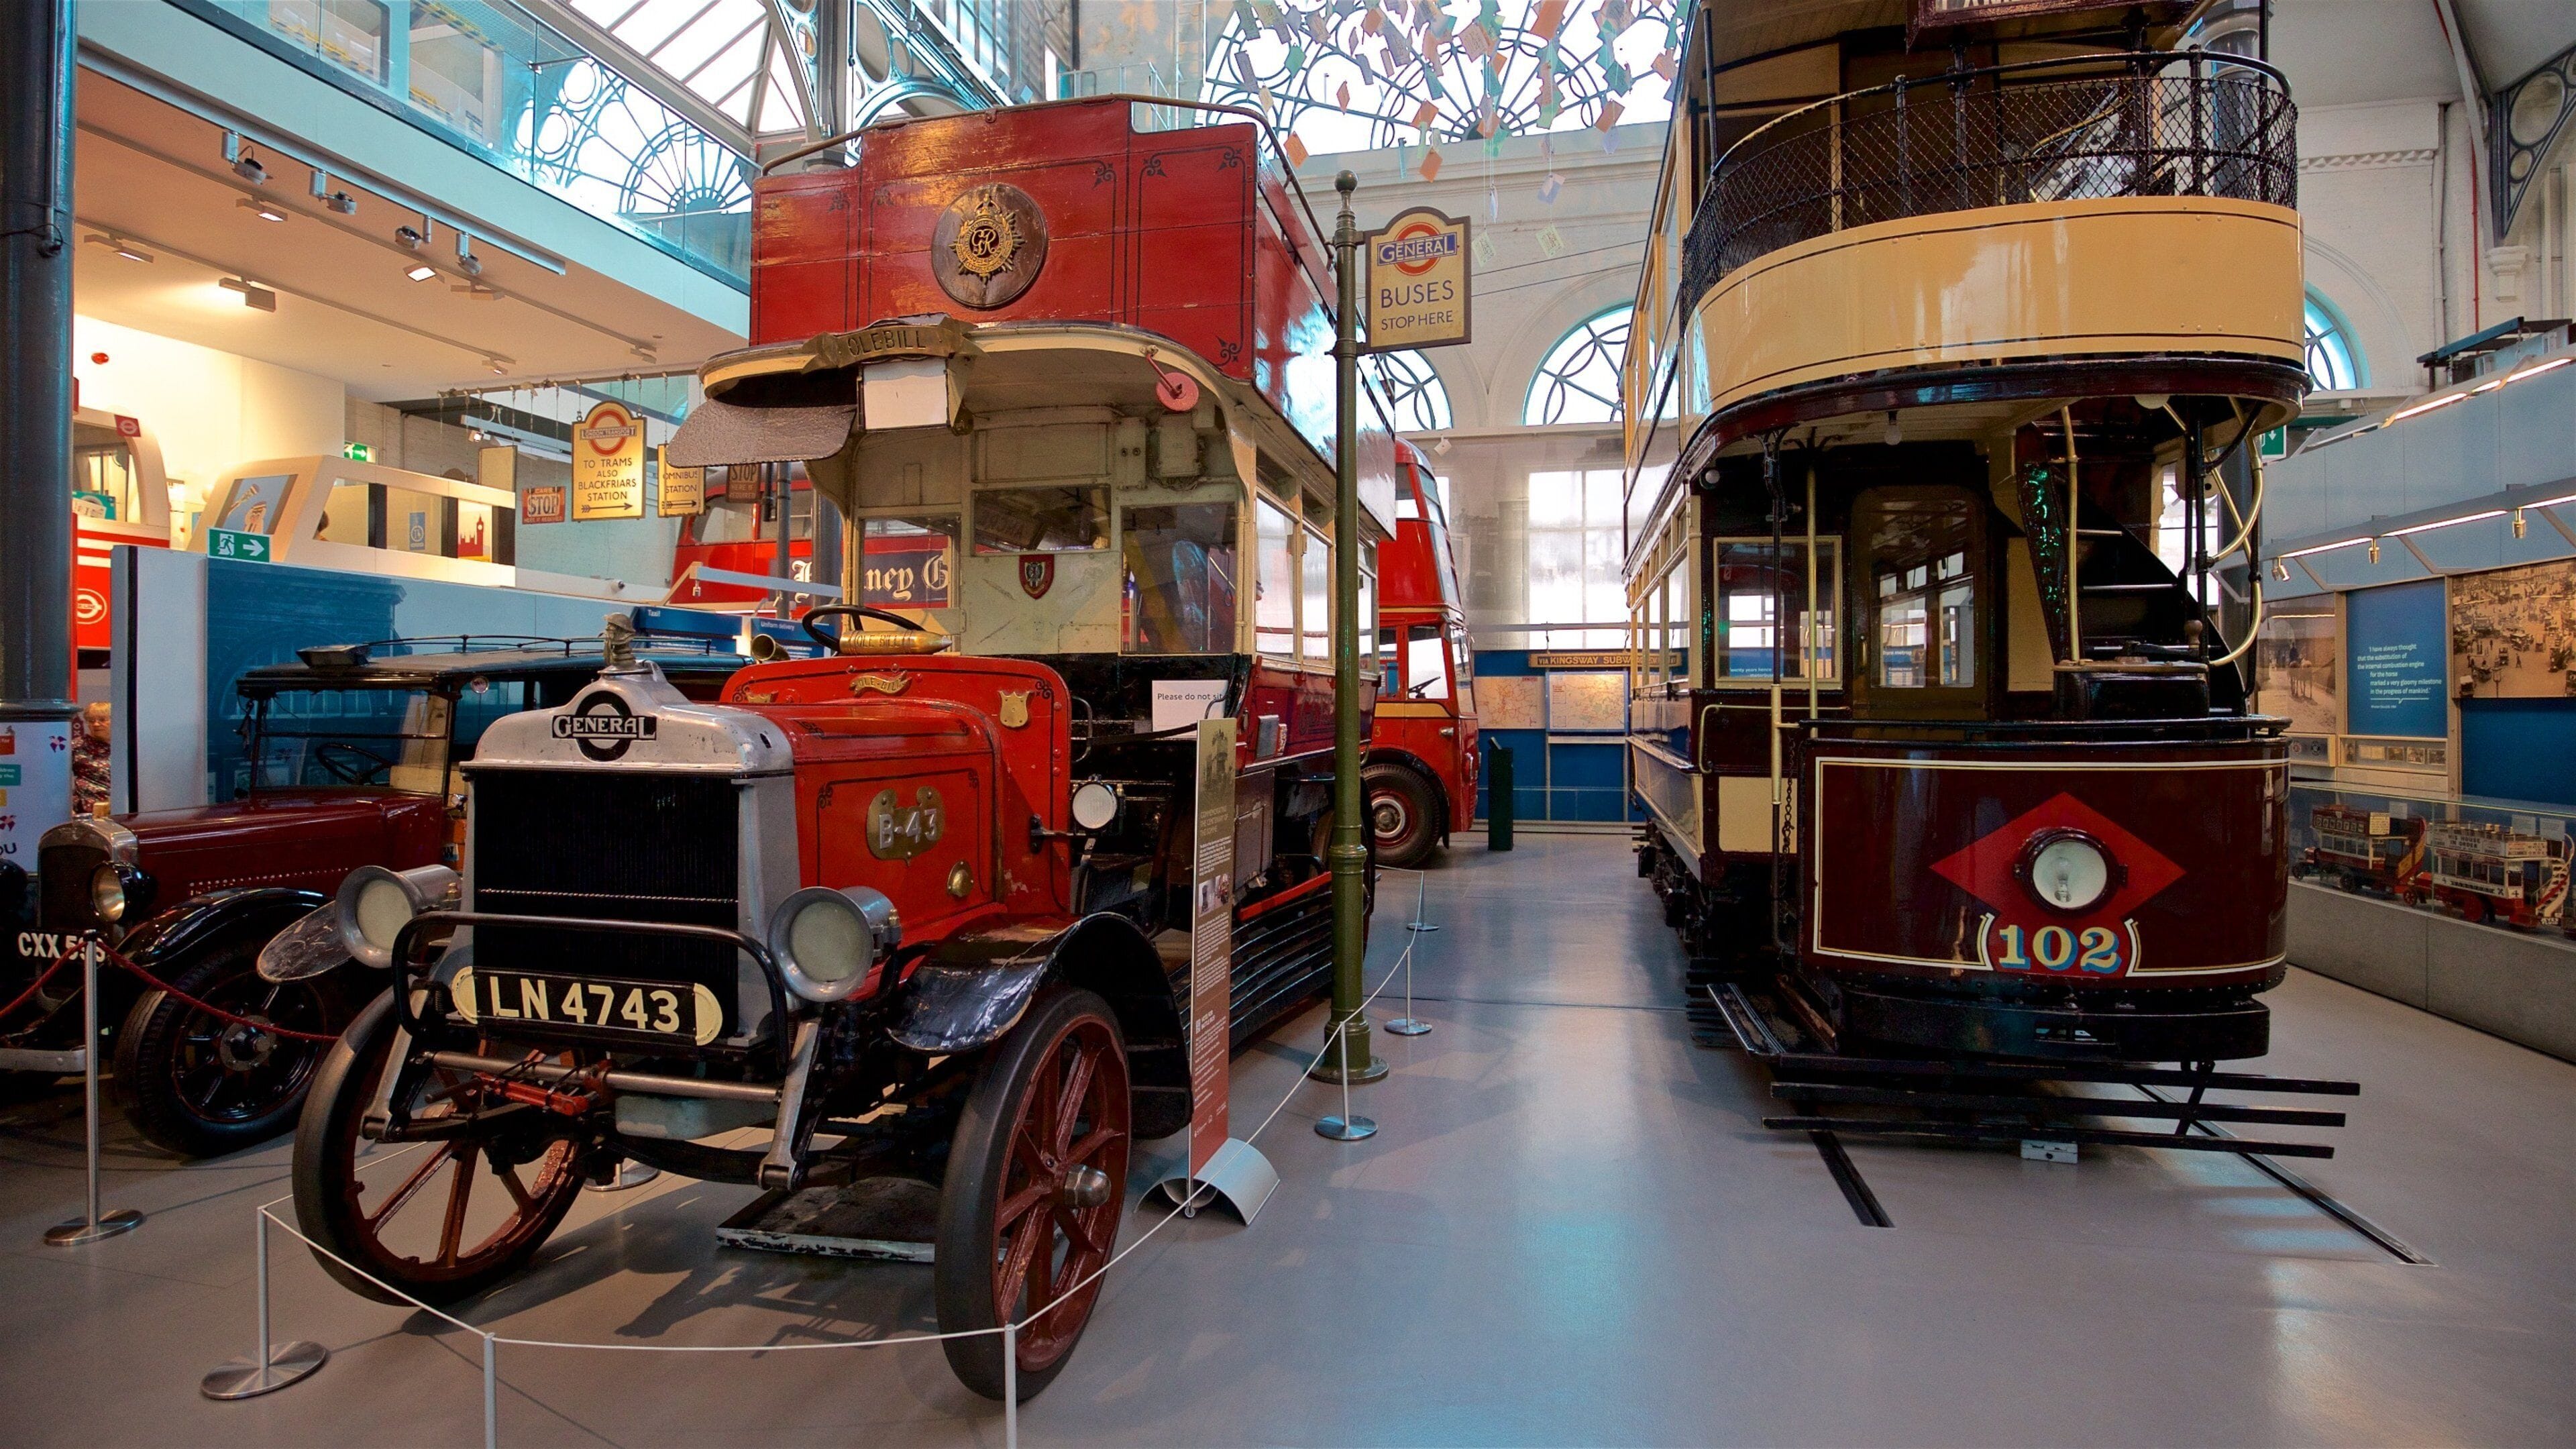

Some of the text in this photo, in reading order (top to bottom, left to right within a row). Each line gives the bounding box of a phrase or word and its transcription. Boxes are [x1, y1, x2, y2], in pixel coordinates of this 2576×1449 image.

[1380, 235, 1454, 262] GENERAL
[1381, 280, 1454, 308] BUSES
[1381, 311, 1453, 330] STOP HERE
[584, 458, 633, 468] TO TRAMS
[596, 470, 618, 478] ALSO
[663, 471, 698, 480] OMNIBUS
[731, 464, 757, 481] STOP
[578, 478, 637, 490] BLACKFRIARS
[665, 484, 697, 493] STATION
[528, 495, 559, 515] STOP
[588, 491, 627, 501] STATION
[1550, 656, 1598, 665] KINGSWAY
[1603, 655, 1631, 664] SUBW
[553, 716, 655, 739] GENERAL
[18, 932, 61, 959] CXX
[1999, 924, 2123, 974] 102
[490, 976, 680, 1033] LN 4743
